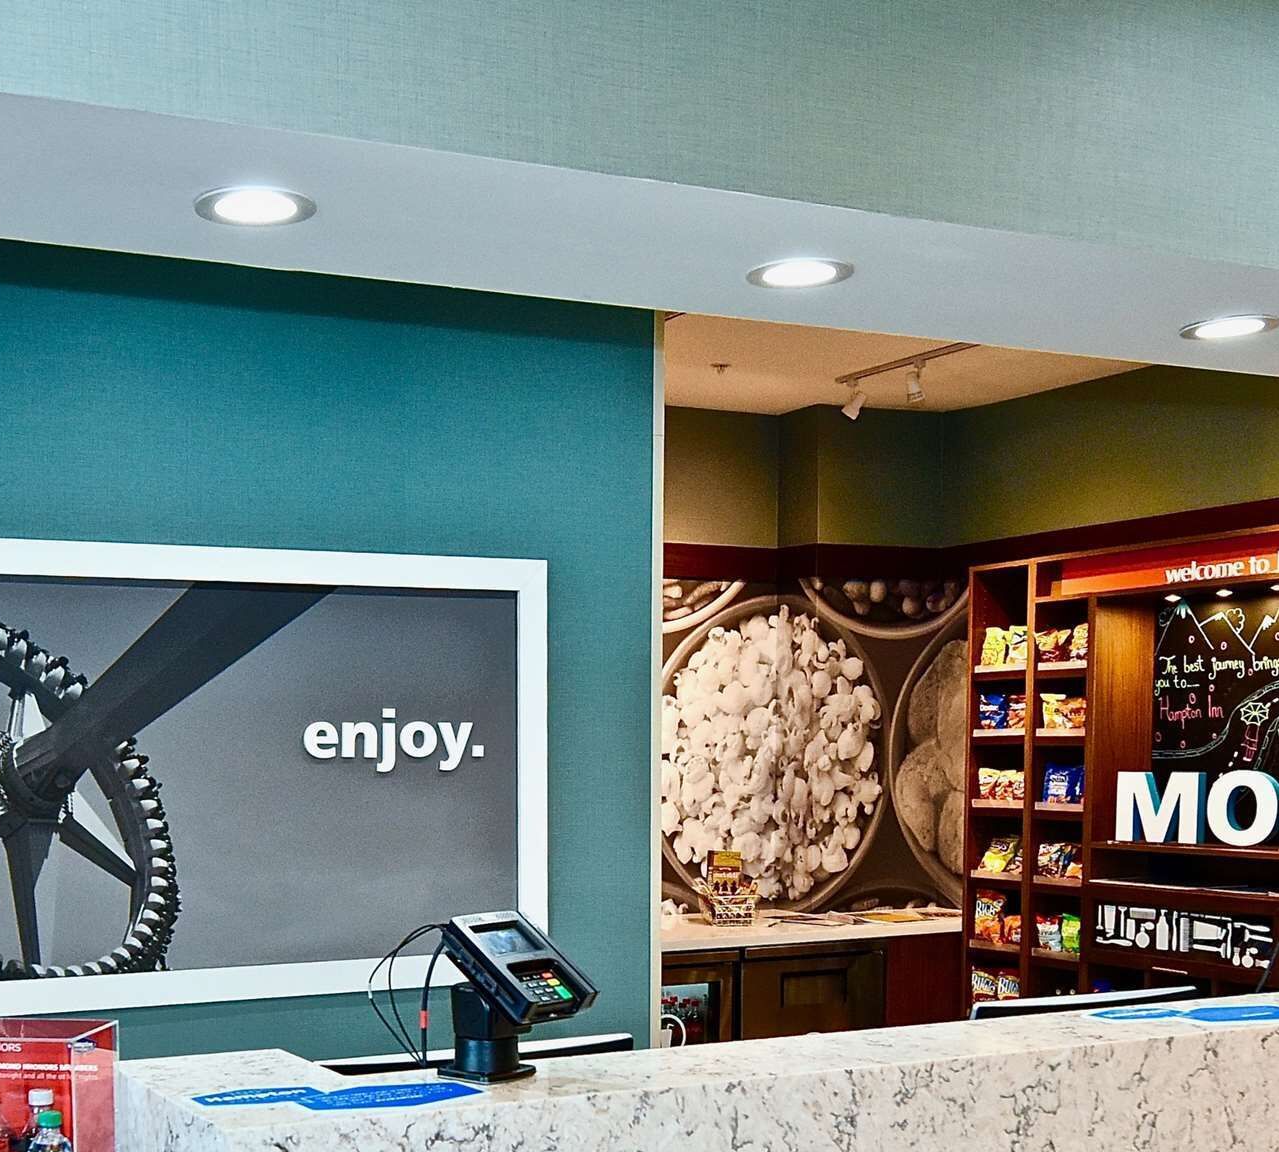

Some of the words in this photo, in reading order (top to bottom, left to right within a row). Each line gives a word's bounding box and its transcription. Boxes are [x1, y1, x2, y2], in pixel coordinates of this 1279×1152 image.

[1165, 560, 1244, 584] welcome
[1249, 556, 1270, 576] to
[1159, 656, 1178, 674] The
[1184, 655, 1205, 674] best
[1154, 680, 1170, 696] you
[1158, 696, 1202, 729] Hampton
[1208, 694, 1224, 719] Inn
[303, 708, 484, 772] enjoy.
